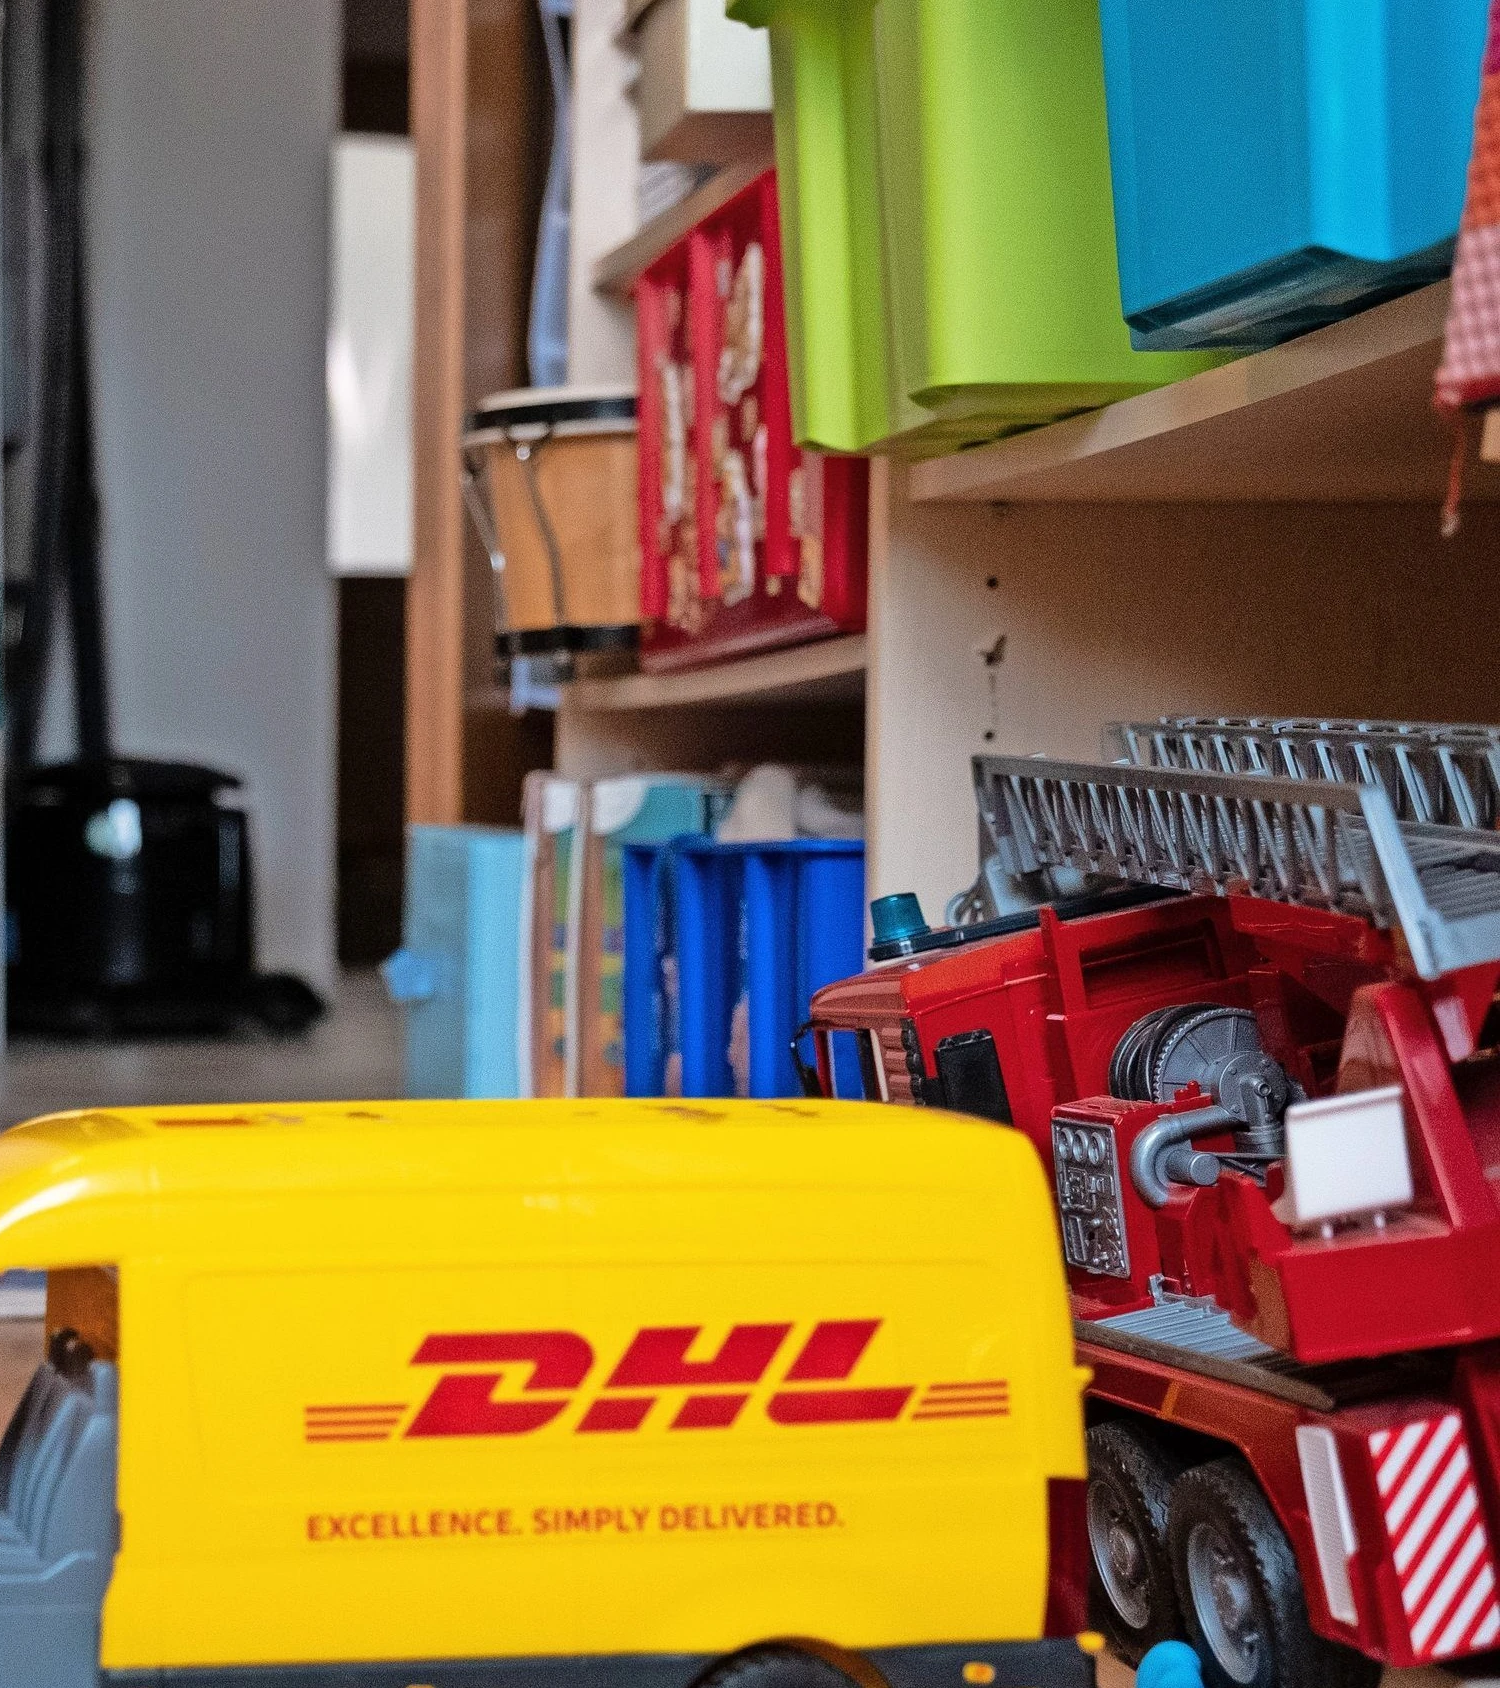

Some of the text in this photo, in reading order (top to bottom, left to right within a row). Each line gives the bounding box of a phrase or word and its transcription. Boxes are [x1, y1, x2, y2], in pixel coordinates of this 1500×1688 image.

[403, 1318, 915, 1440] DHL
[305, 1501, 844, 1542] EXCELLENCE. SIMPLY DELIVERED.
